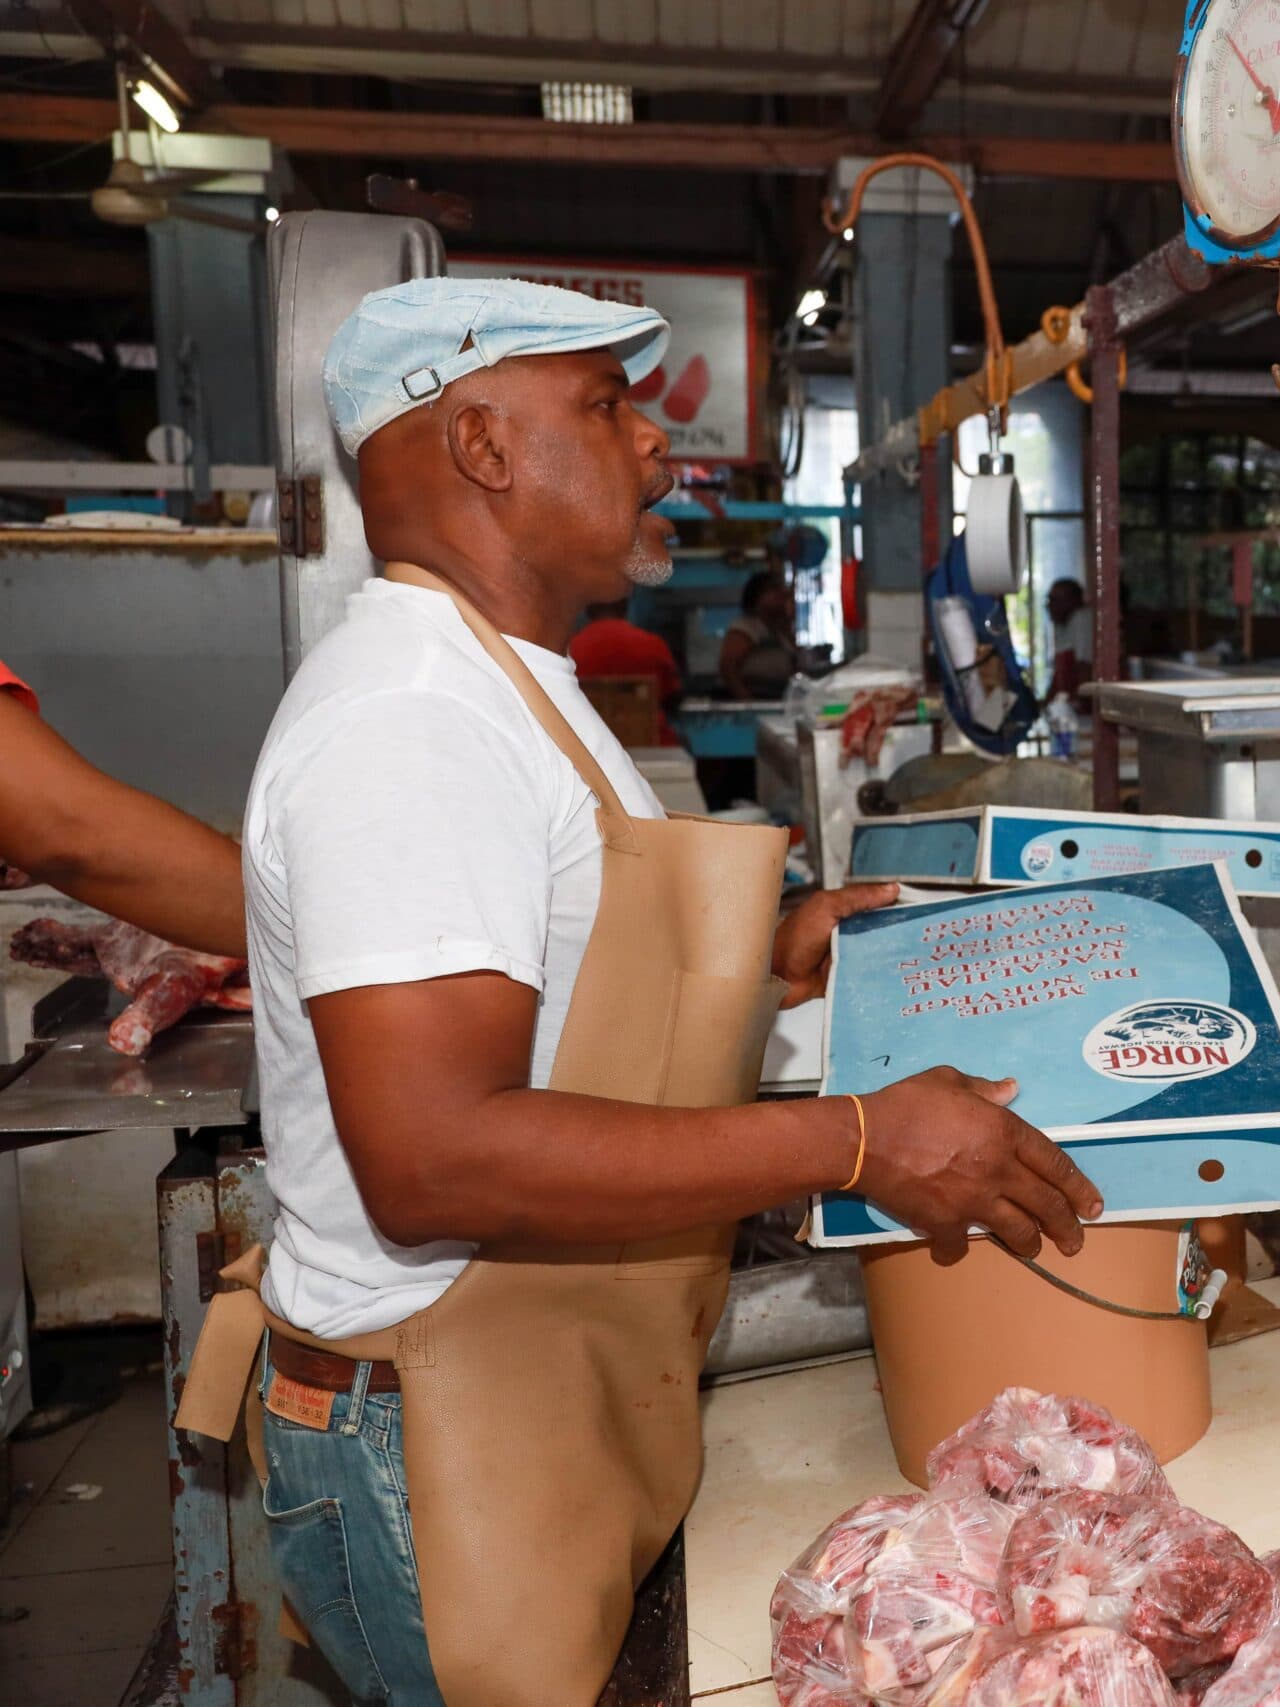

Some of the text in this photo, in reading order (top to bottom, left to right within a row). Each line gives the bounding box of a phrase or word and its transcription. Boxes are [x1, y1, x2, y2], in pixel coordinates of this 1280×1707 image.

[900, 968, 1140, 1017] DE NORVEGE
[958, 984, 1087, 1017] MORUE
[1099, 1041, 1142, 1050] NORWAY
[1099, 1045, 1229, 1070] NORGE
